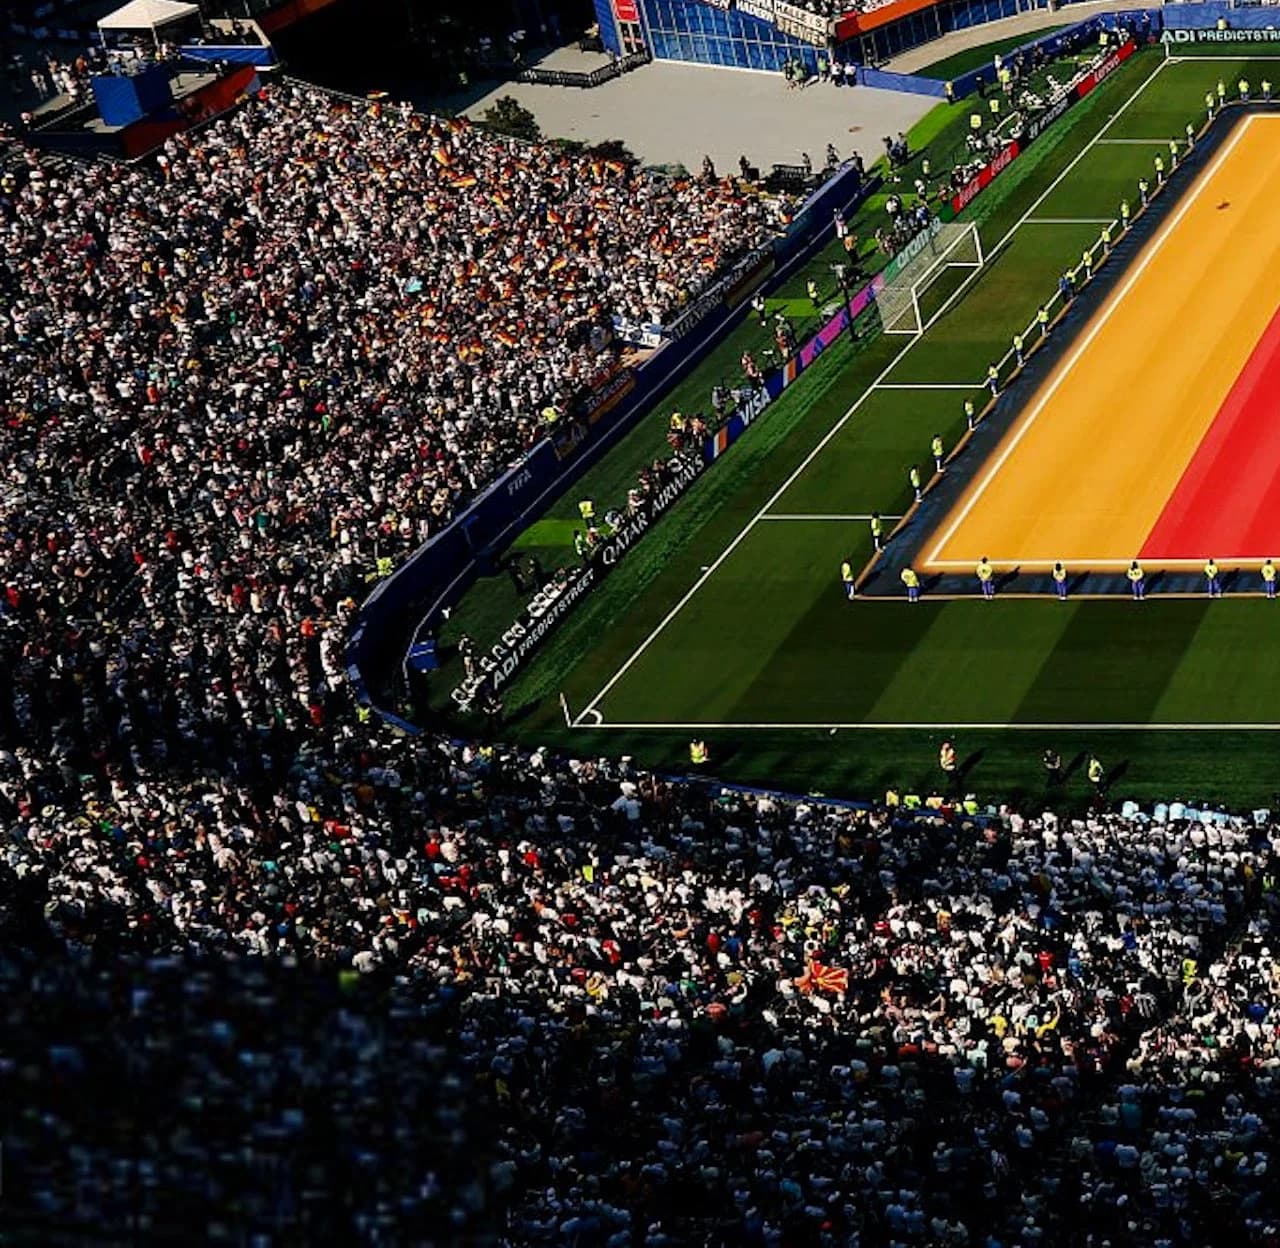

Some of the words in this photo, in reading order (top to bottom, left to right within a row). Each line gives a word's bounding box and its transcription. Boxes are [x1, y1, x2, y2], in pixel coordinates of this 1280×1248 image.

[1160, 30, 1196, 43] ADI
[738, 386, 771, 426] VISA
[602, 511, 649, 565] QATAR
[651, 454, 705, 518] AIRWAYS
[493, 650, 519, 691] ADI
